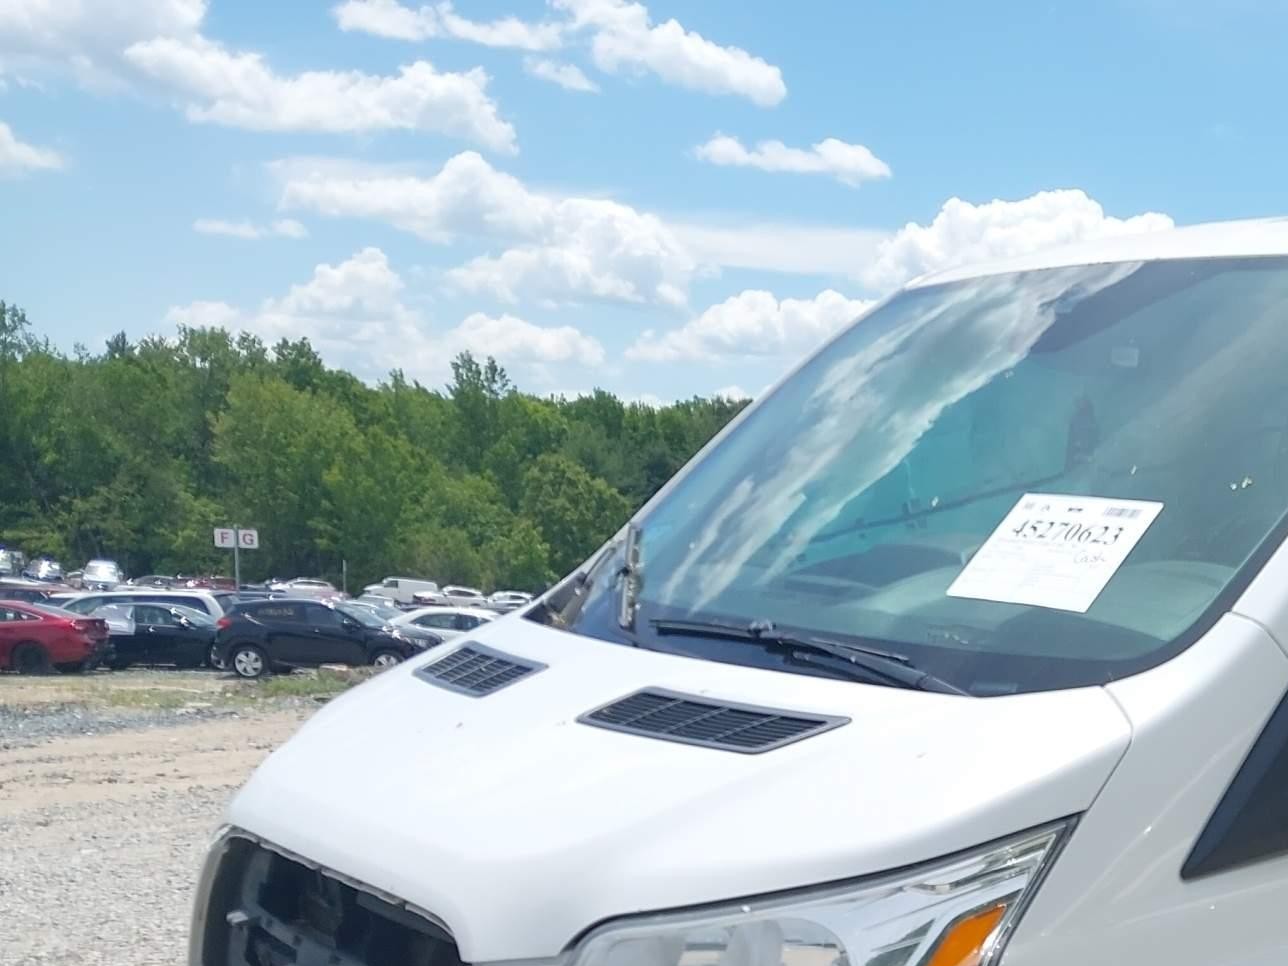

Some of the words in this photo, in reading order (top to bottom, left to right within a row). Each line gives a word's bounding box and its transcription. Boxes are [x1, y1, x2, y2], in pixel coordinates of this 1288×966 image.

[220, 531, 229, 545] F
[1012, 519, 1125, 545] 45270623
[242, 533, 255, 546] G
